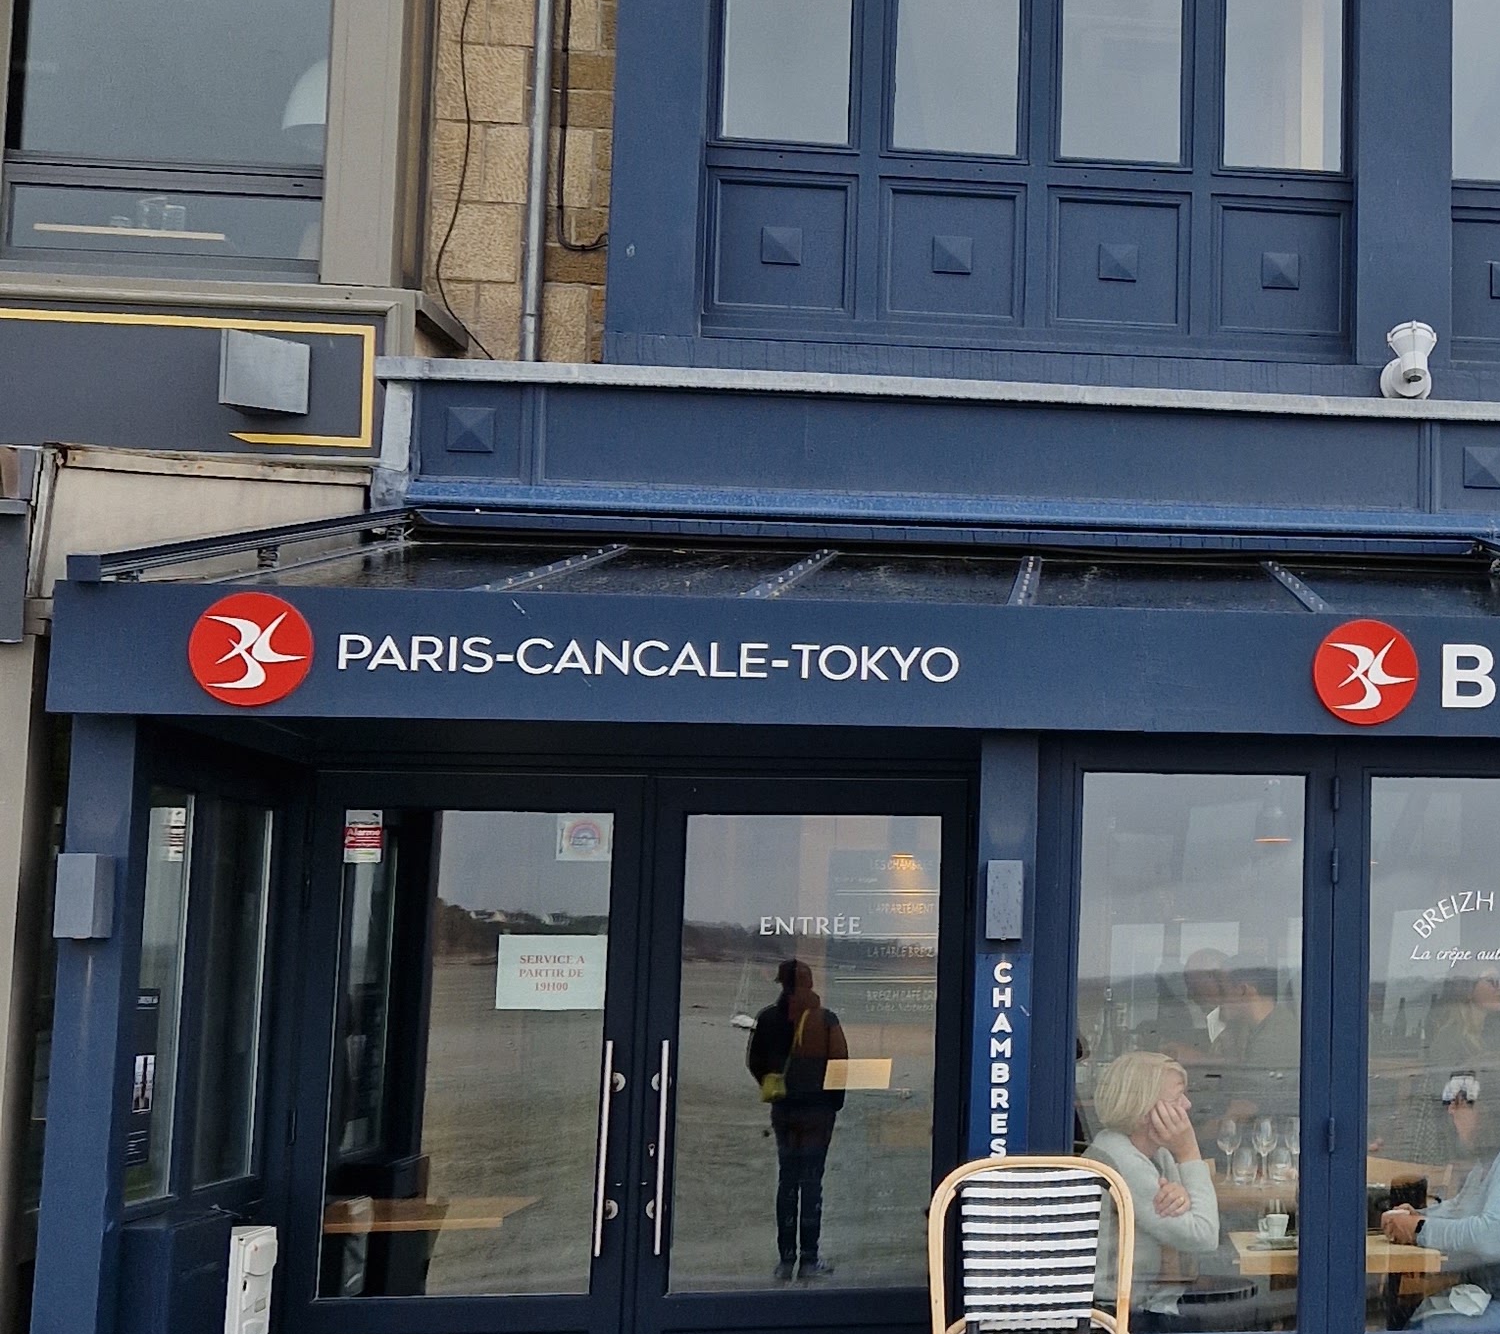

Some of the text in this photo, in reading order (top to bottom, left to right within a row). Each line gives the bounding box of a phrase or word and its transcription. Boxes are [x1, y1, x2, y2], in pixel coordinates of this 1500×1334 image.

[336, 633, 960, 683] PARIS-CANCALE-TOKYO
[760, 913, 862, 936] ENTRÉE
[1412, 890, 1494, 939] BREIZH
[519, 954, 574, 965] SERVICE
[1410, 944, 1432, 961] La
[1436, 947, 1473, 968] crêpe
[519, 968, 584, 978] PARTIR DE
[535, 982, 569, 992] 19H00
[989, 961, 1014, 1159] CHAMBRES
